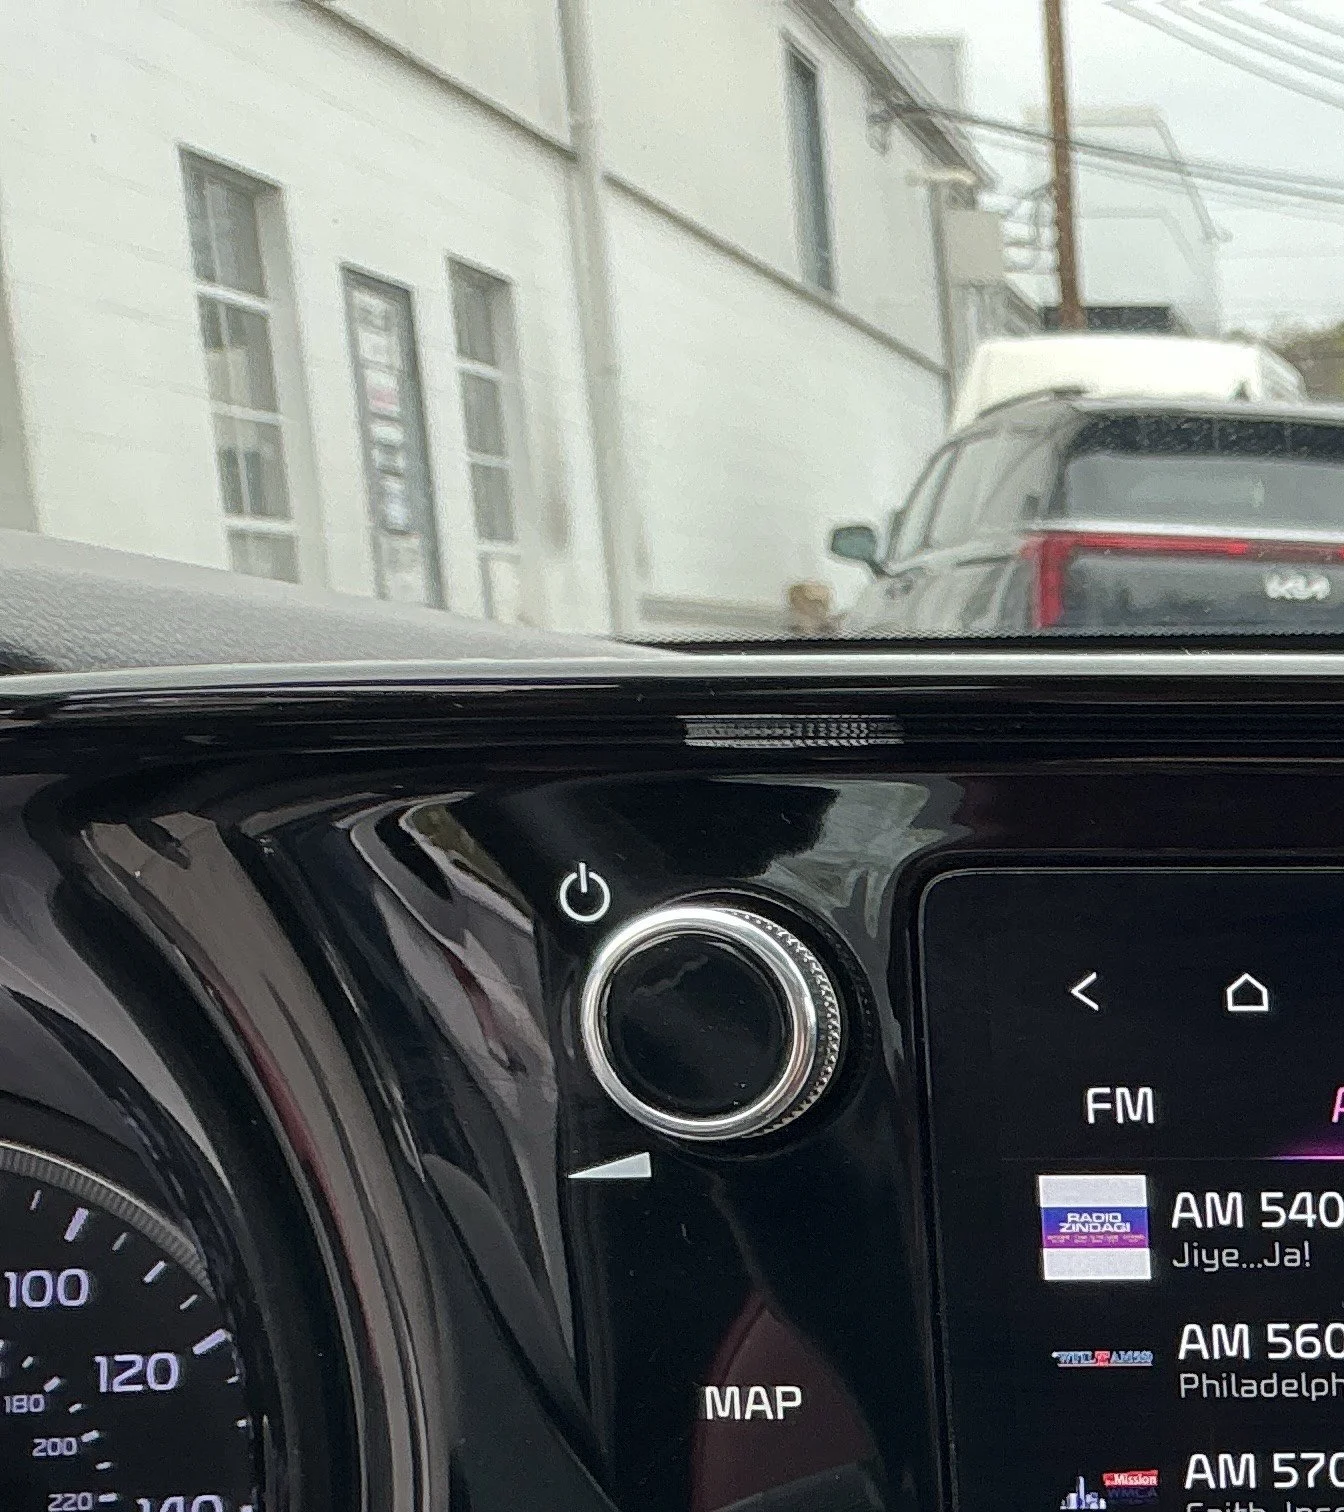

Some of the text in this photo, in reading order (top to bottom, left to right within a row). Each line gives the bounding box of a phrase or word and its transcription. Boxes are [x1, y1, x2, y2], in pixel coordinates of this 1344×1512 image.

[1087, 1087, 1154, 1123] FM
[1172, 1192, 1243, 1228] AM
[1261, 1192, 1344, 1228] 540
[1173, 1241, 1310, 1272] Jiye...Ja!
[5, 1269, 89, 1307] 100
[1179, 1324, 1250, 1359] AM
[95, 1353, 179, 1392] 120
[4, 1394, 45, 1413] 180
[705, 1386, 801, 1419] MAP
[32, 1437, 77, 1456] 200
[1185, 1453, 1256, 1489] AM
[48, 1492, 93, 1512] 220
